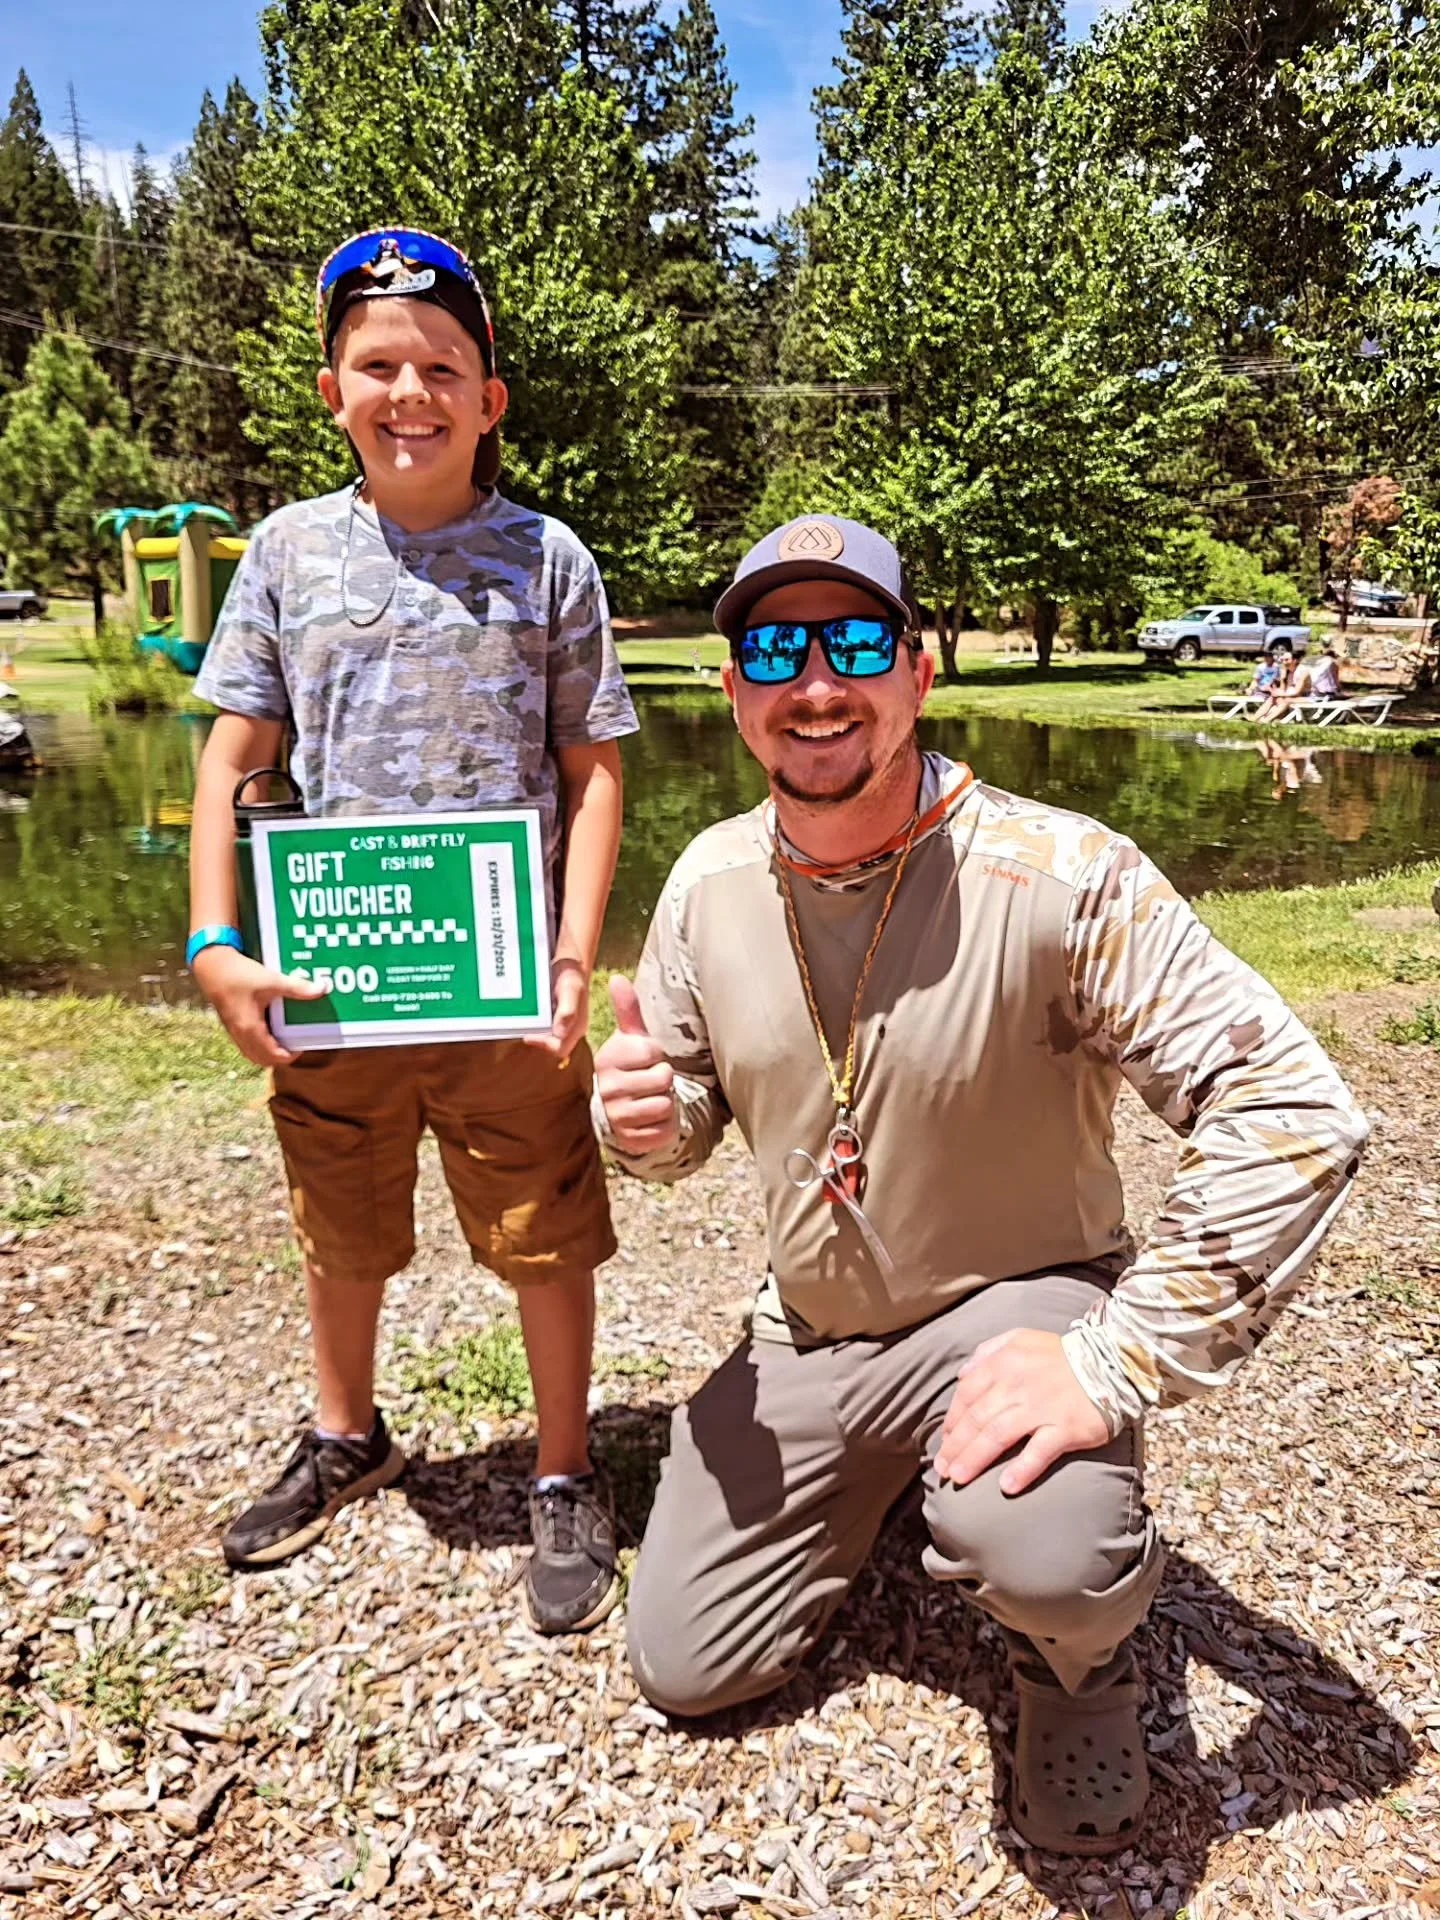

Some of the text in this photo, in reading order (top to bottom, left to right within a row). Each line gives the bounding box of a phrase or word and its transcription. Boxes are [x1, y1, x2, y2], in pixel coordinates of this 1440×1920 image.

[351, 832, 466, 850] CAST & DRIFT FLY
[287, 851, 346, 884] GIFT
[381, 855, 435, 871] FISHING
[982, 863, 1031, 888] SIMMS
[488, 861, 501, 909] EXPIRES
[289, 884, 412, 918] VOUCHER
